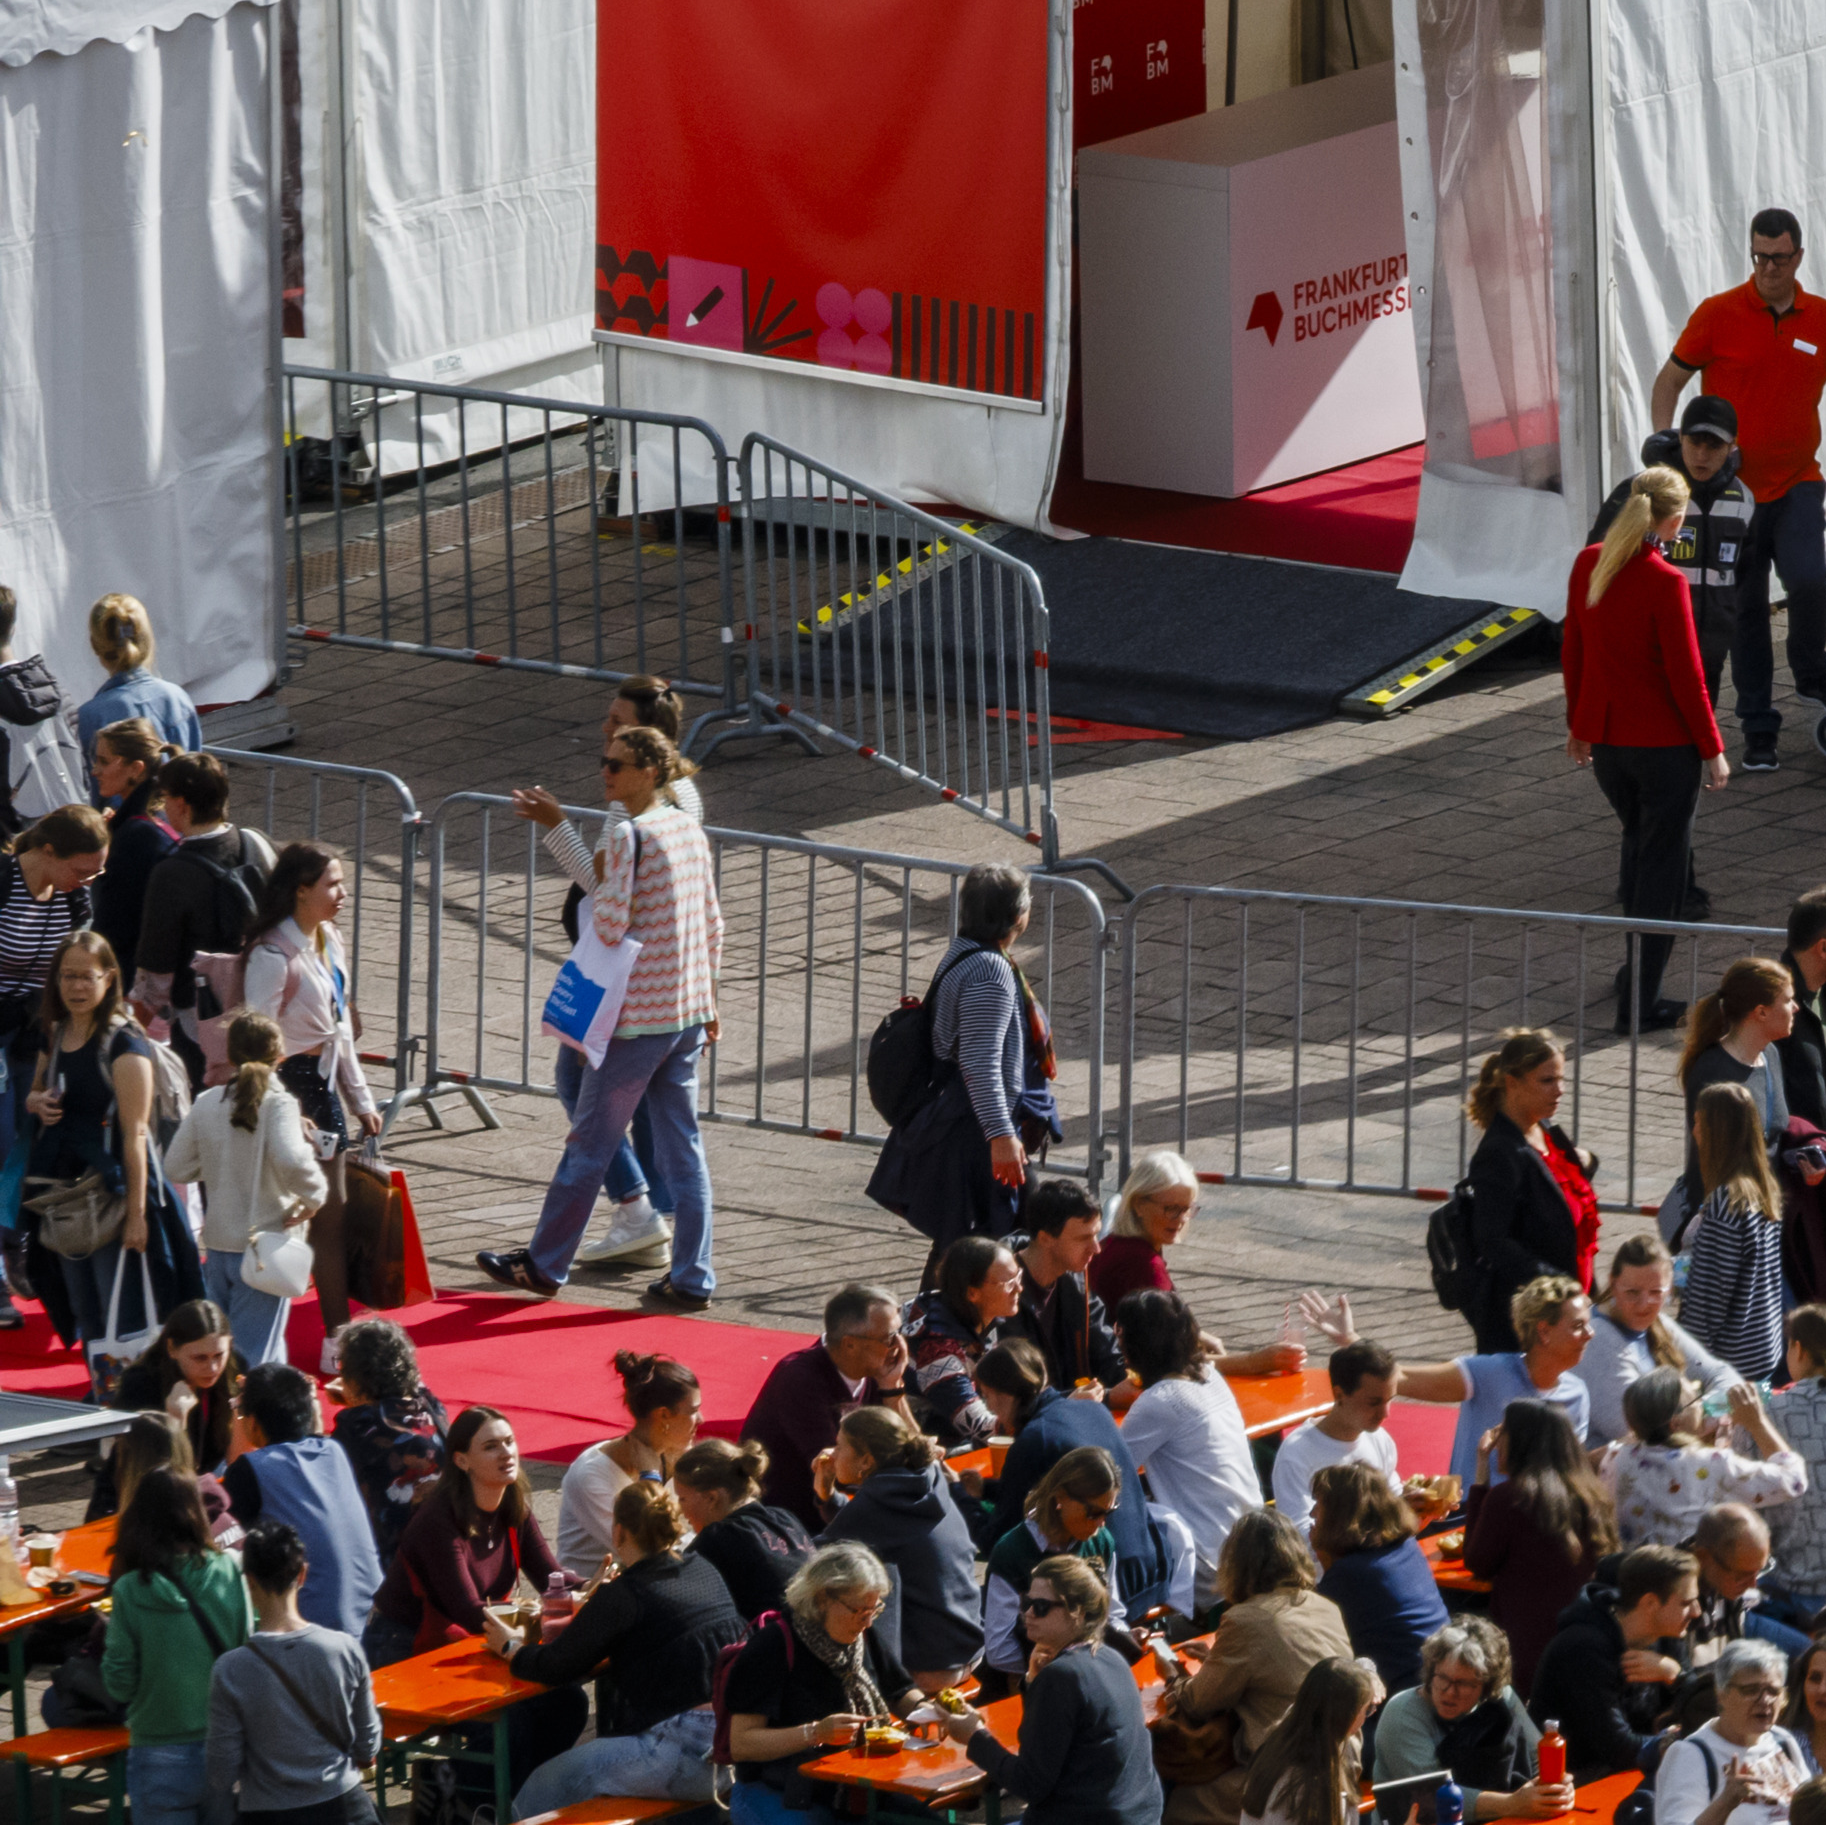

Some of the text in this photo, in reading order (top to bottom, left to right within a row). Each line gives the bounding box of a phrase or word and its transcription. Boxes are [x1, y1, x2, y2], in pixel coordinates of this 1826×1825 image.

[1147, 58, 1169, 80] BM
[1091, 73, 1113, 96] BM
[1294, 284, 1412, 343] BUCHMESS
